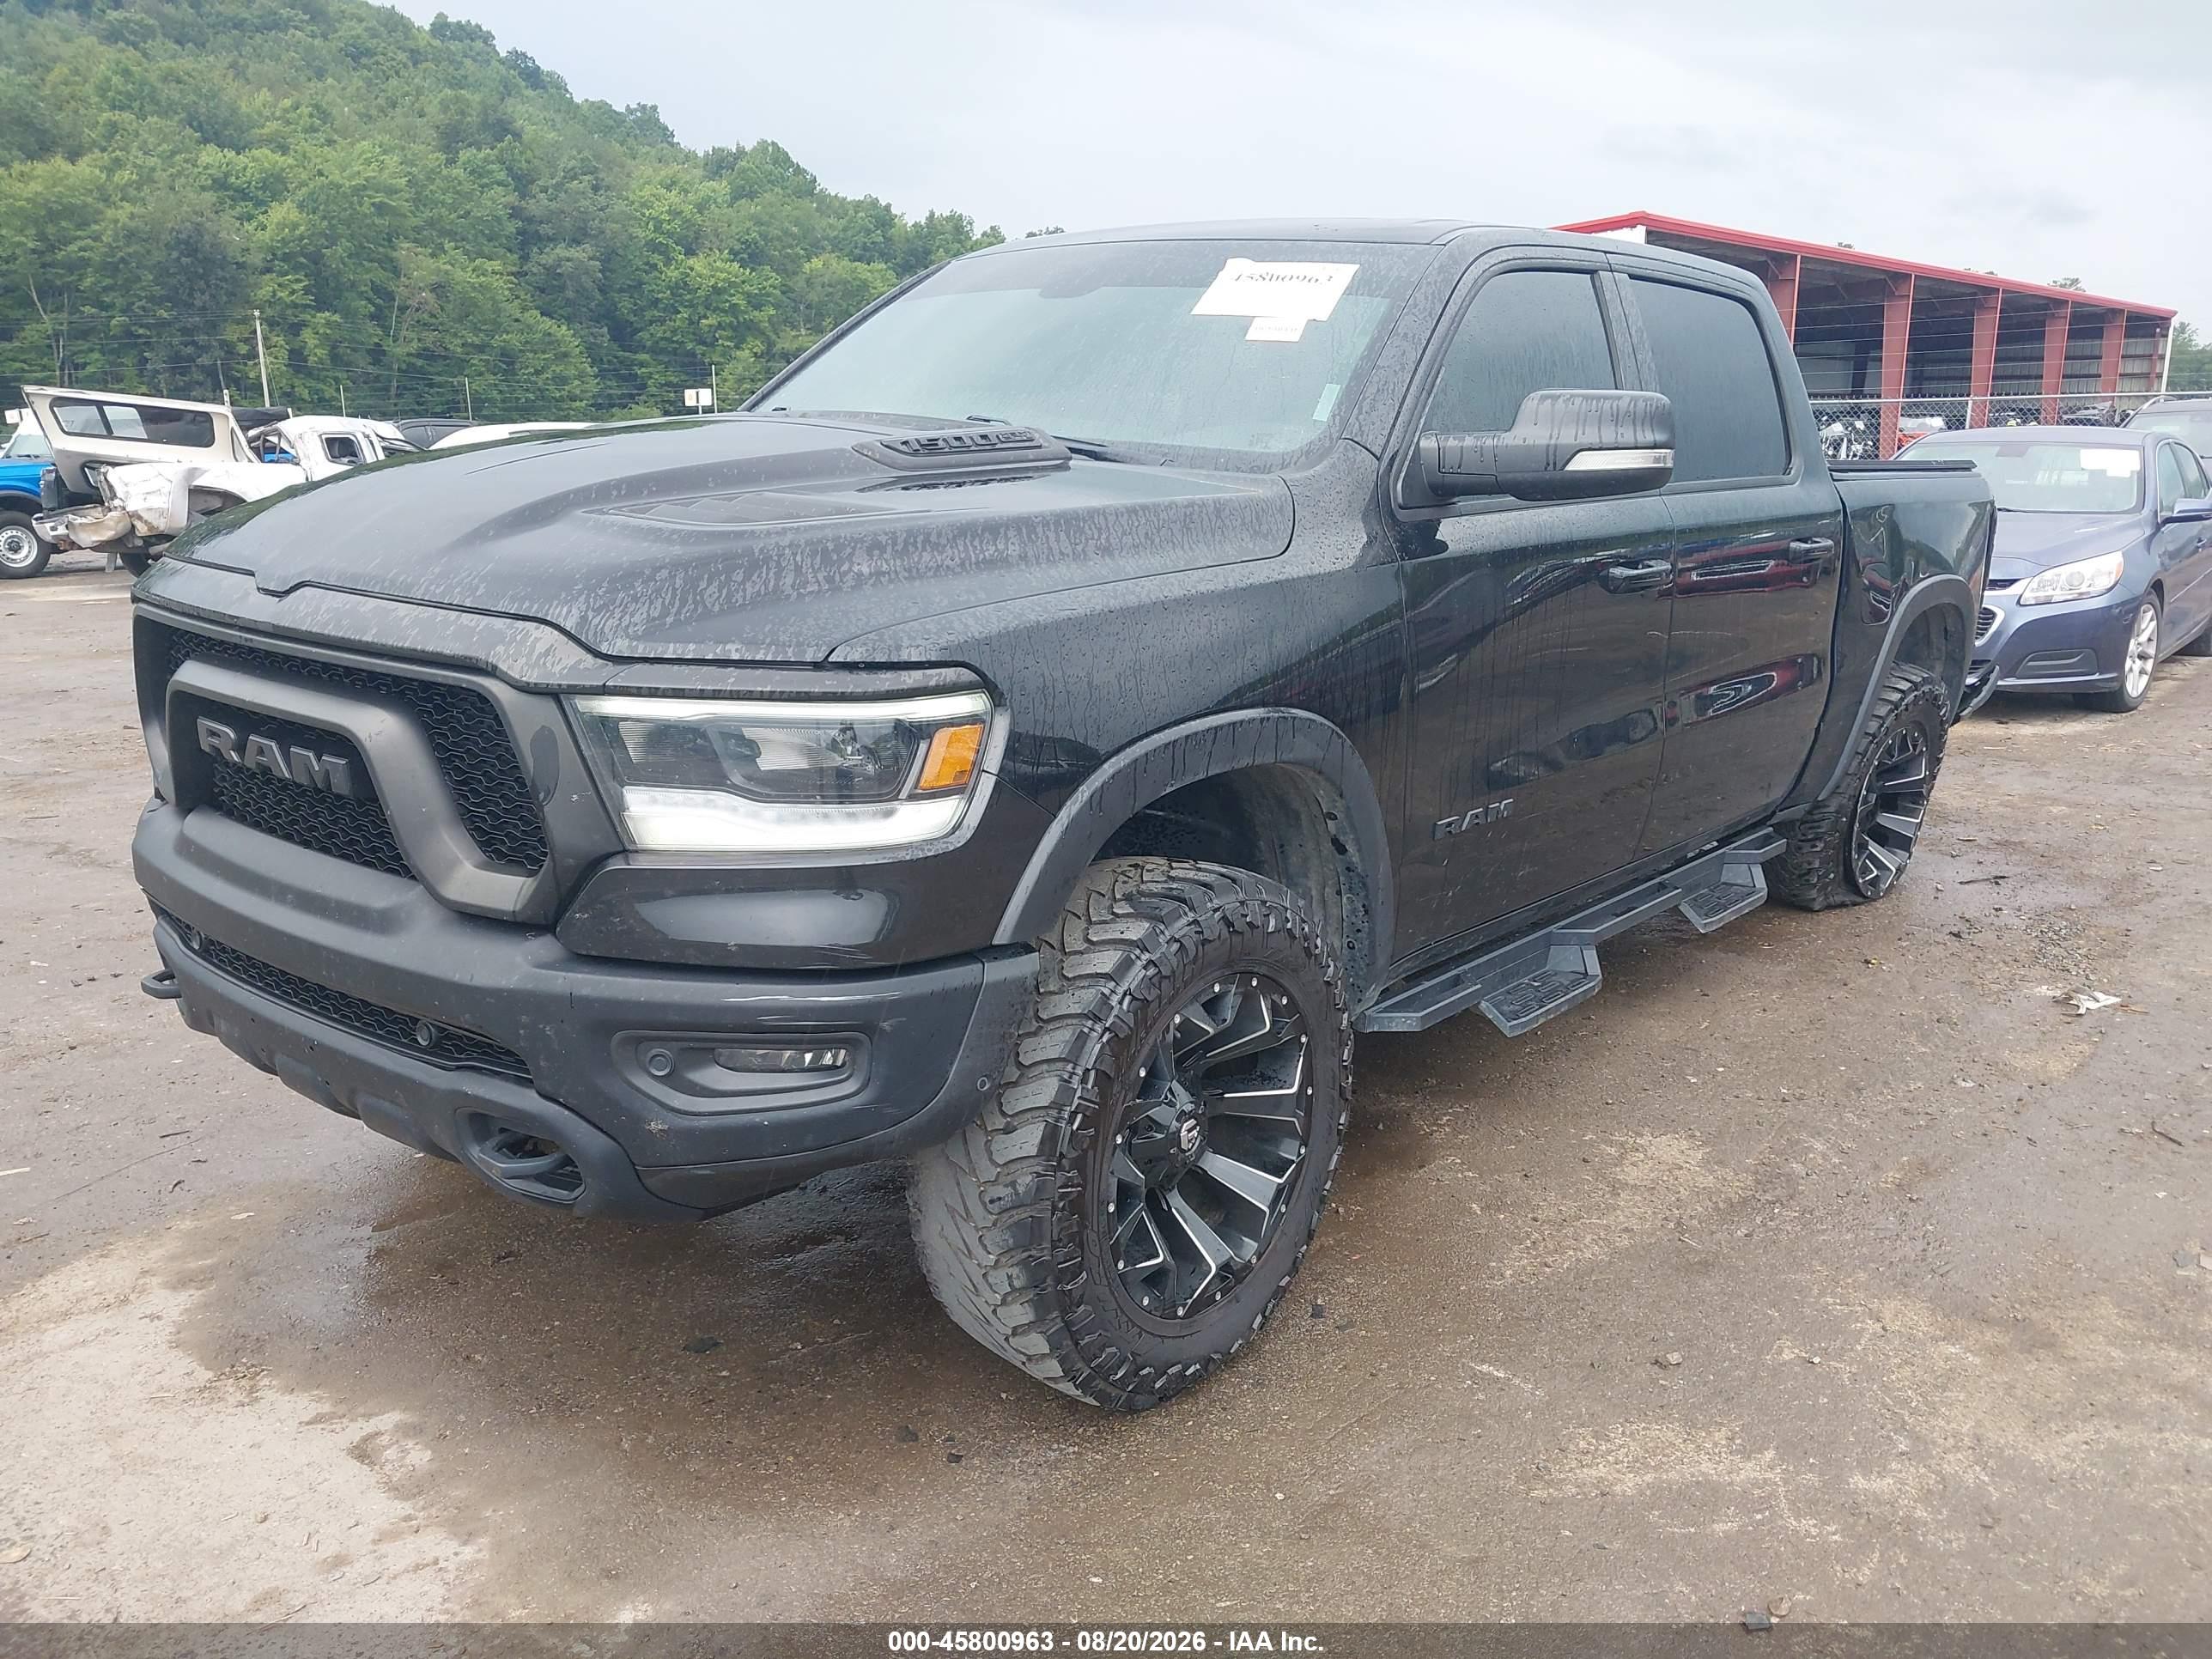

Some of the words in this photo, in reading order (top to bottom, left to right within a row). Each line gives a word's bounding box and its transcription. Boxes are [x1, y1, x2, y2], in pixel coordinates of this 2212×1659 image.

[900, 432, 999, 453] 1500
[197, 715, 350, 796] RAM
[1432, 798, 1514, 841] RAM
